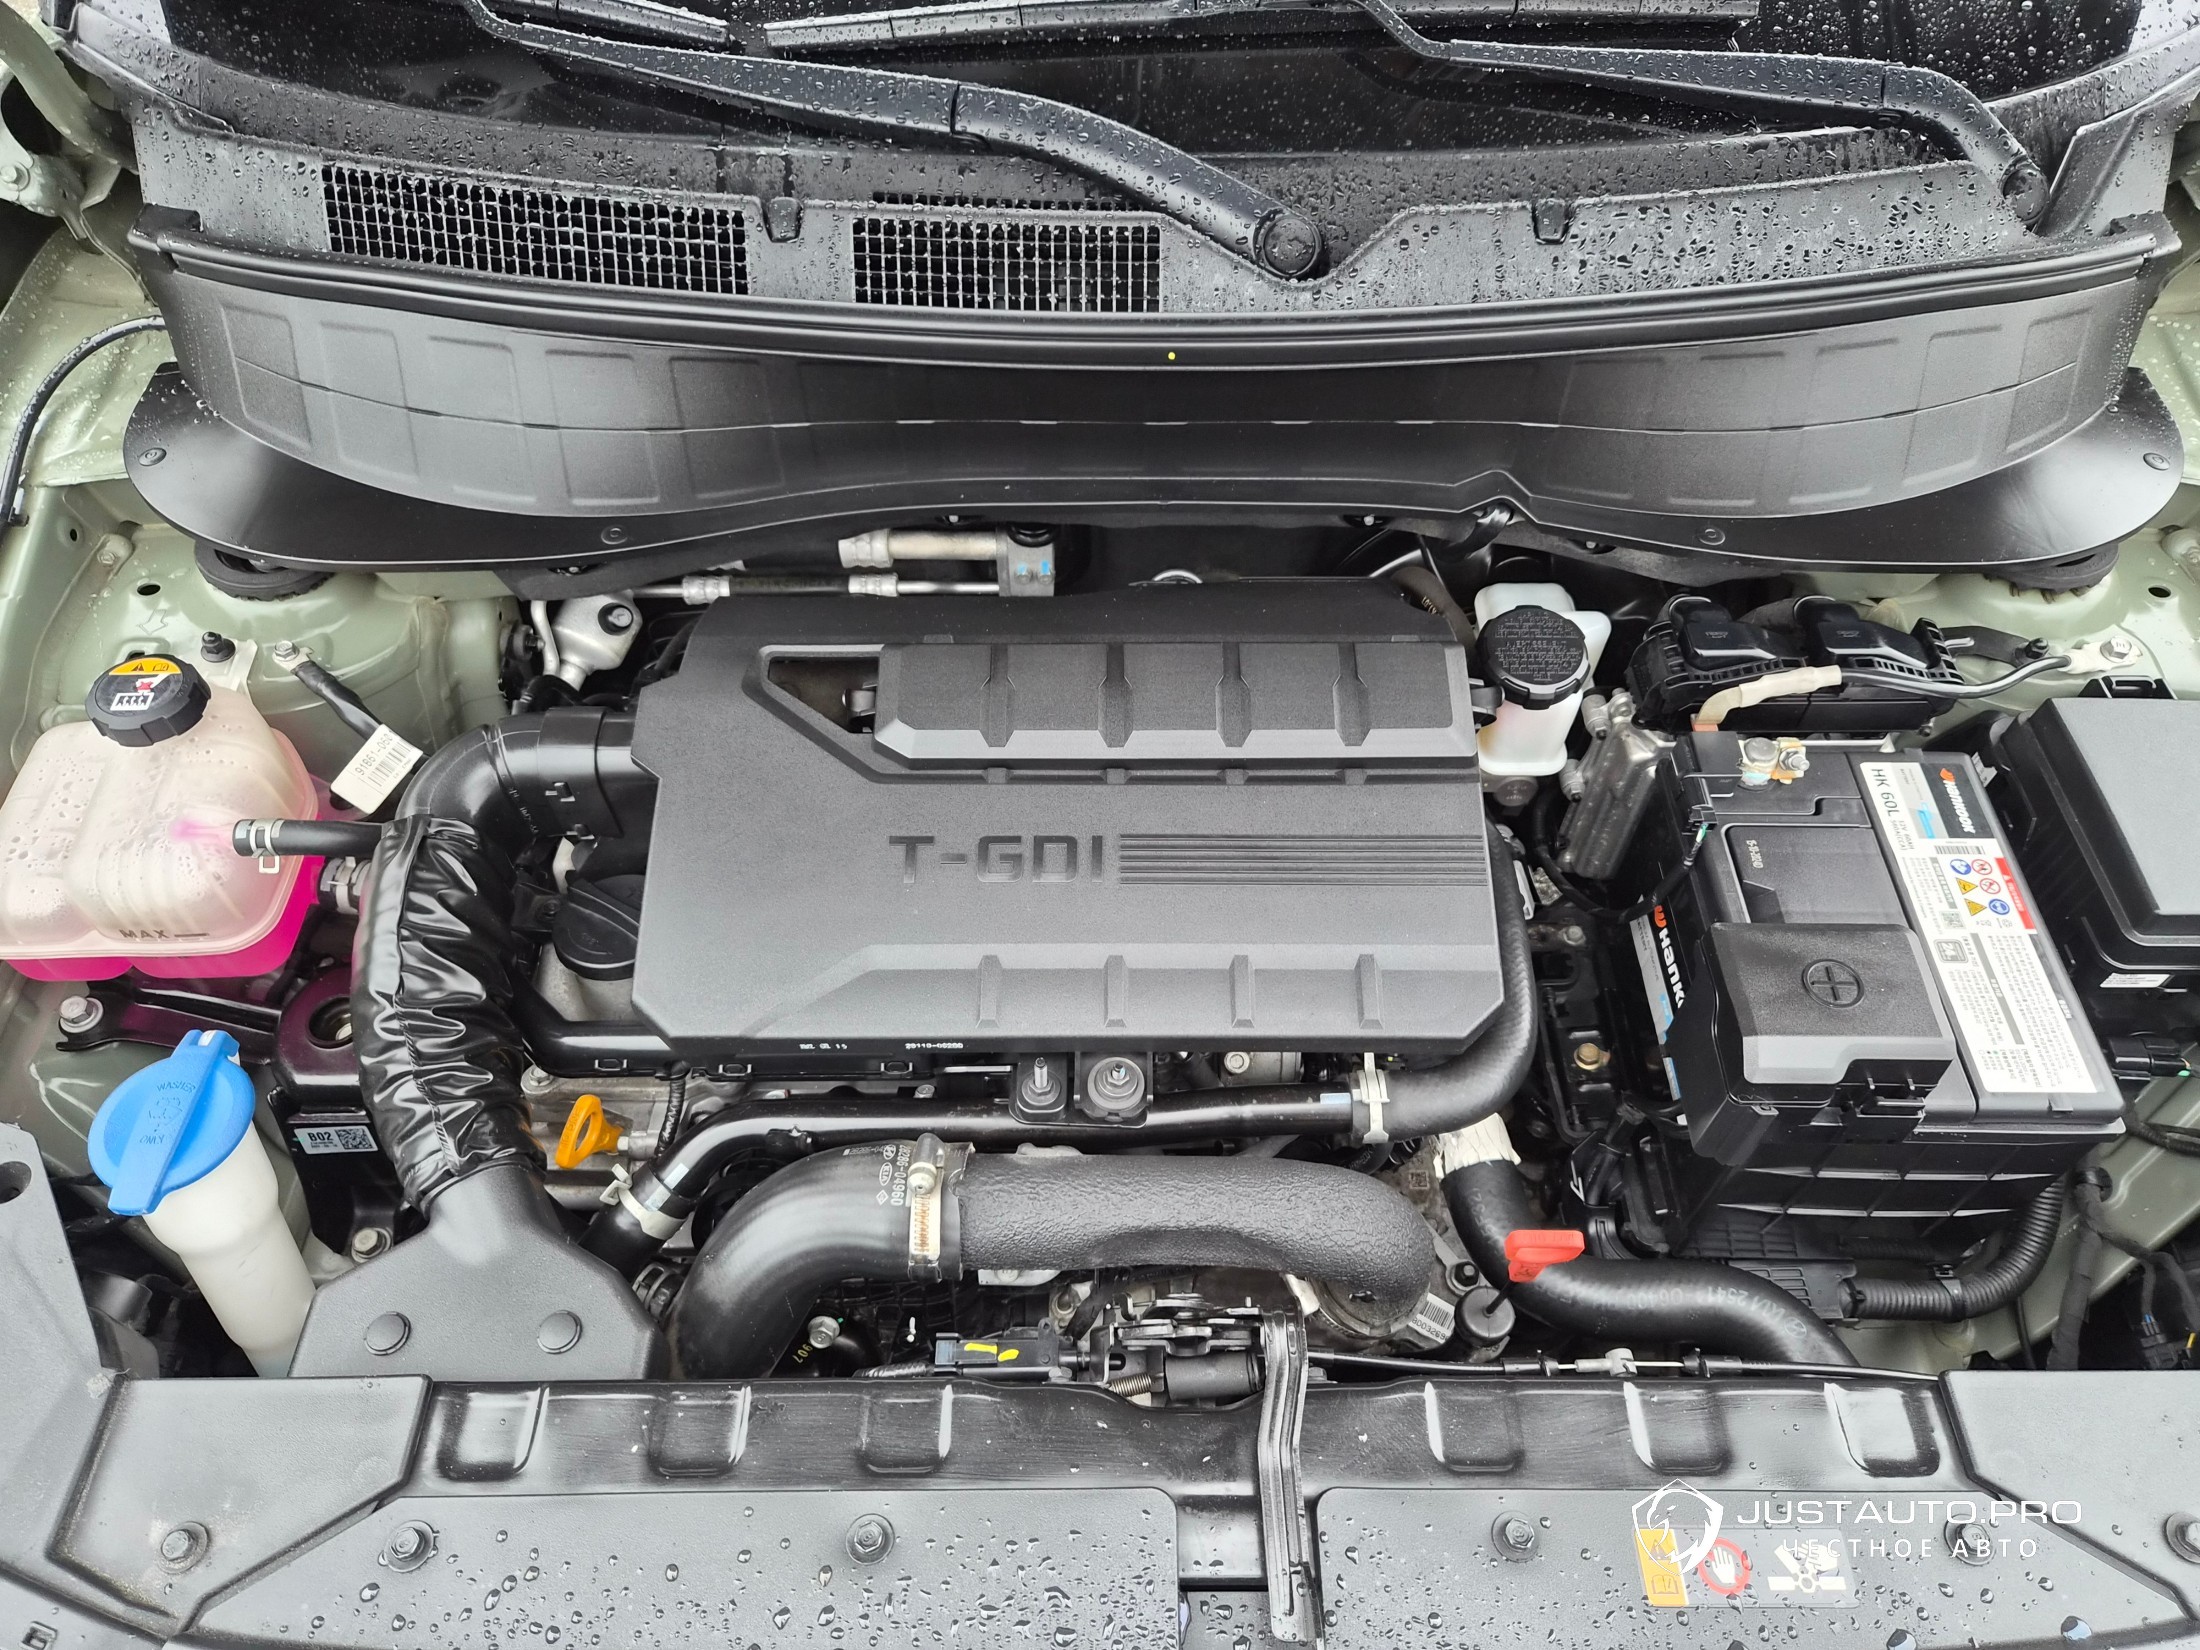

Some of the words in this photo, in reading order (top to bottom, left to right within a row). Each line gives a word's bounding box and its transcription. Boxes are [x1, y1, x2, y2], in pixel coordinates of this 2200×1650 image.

[1871, 768, 1889, 787] HK
[889, 835, 1103, 883] T-GDI
[119, 929, 170, 939] MAX
[157, 1080, 196, 1093] WASHER
[139, 1134, 165, 1145] ONLY
